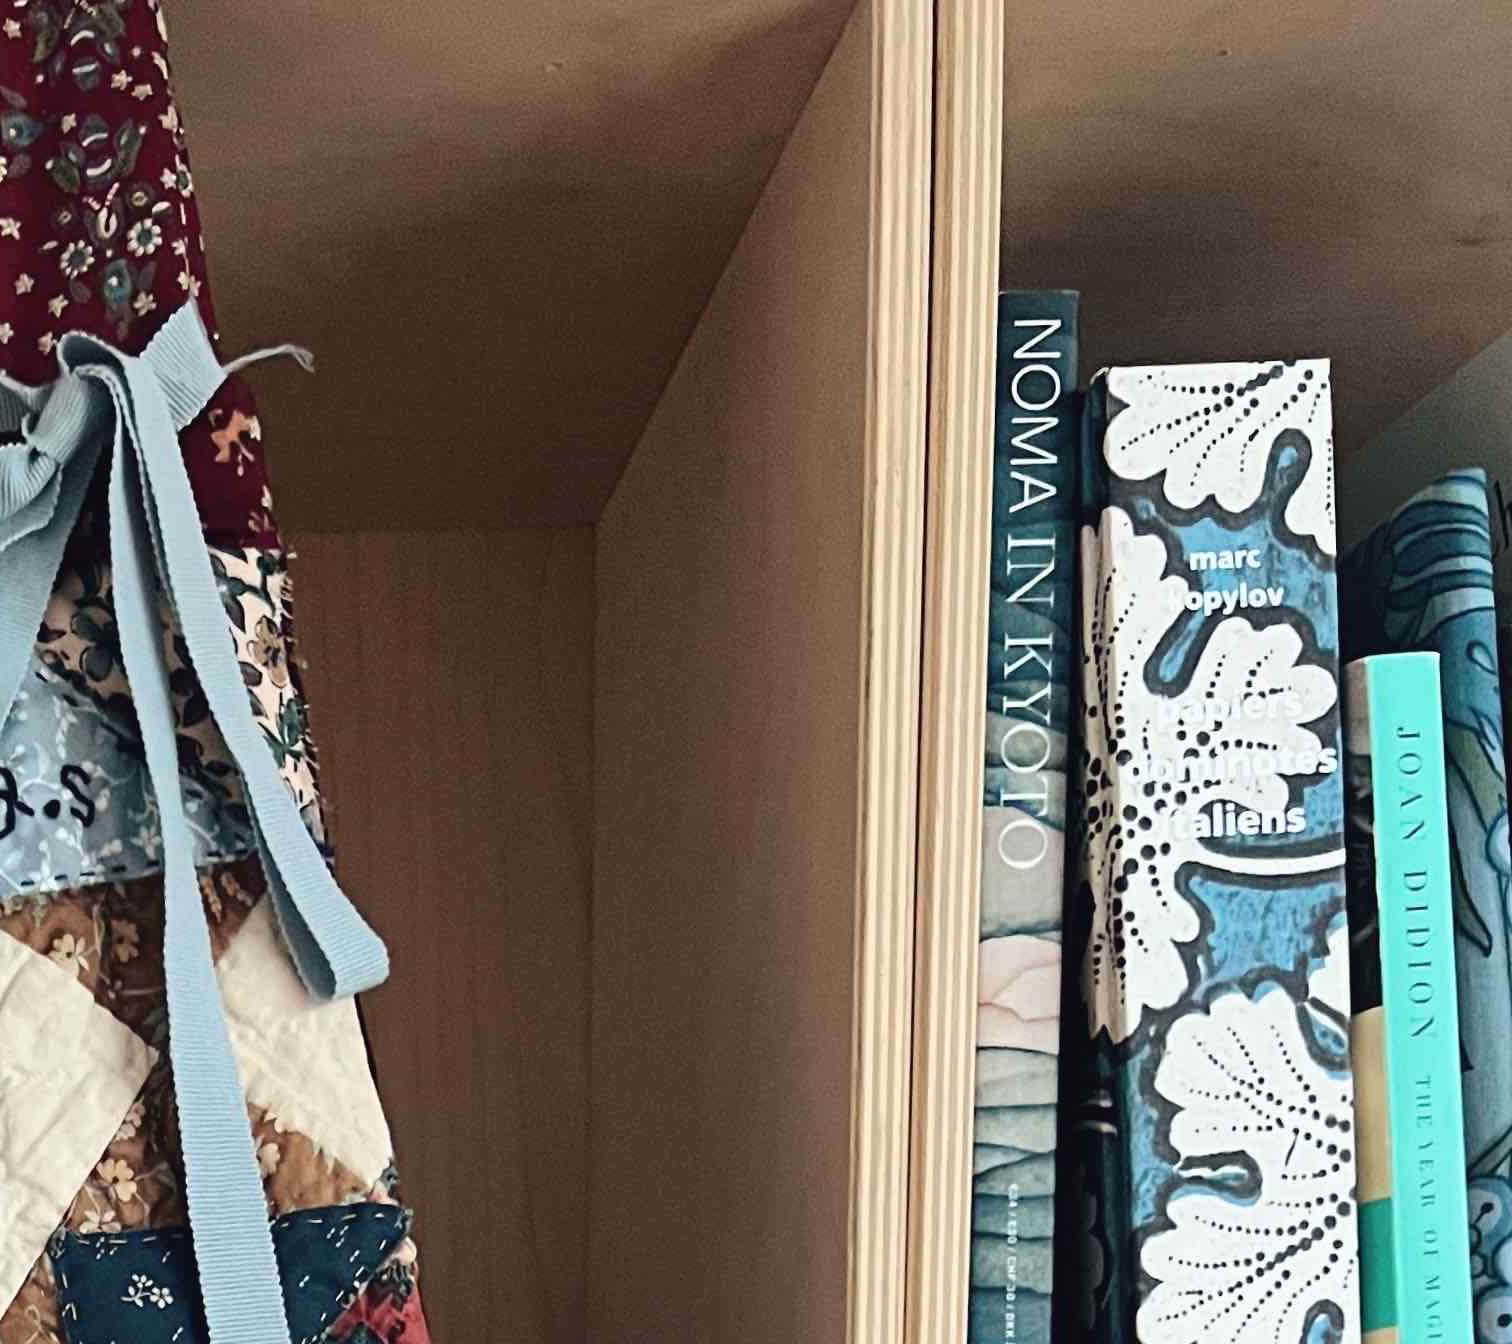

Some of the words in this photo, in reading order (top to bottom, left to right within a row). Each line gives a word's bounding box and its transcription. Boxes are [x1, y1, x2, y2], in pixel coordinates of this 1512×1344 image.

[1008, 318, 1063, 513] NOMA
[1005, 533, 1057, 608] IN
[1188, 545, 1262, 572] marc
[996, 632, 1054, 870] KYOTO
[1395, 725, 1426, 842] JOAN
[1402, 869, 1436, 1040] DIDION
[1411, 1074, 1432, 1128] THE
[1416, 1134, 1436, 1208] YEAR
[1422, 1230, 1439, 1265] OF
